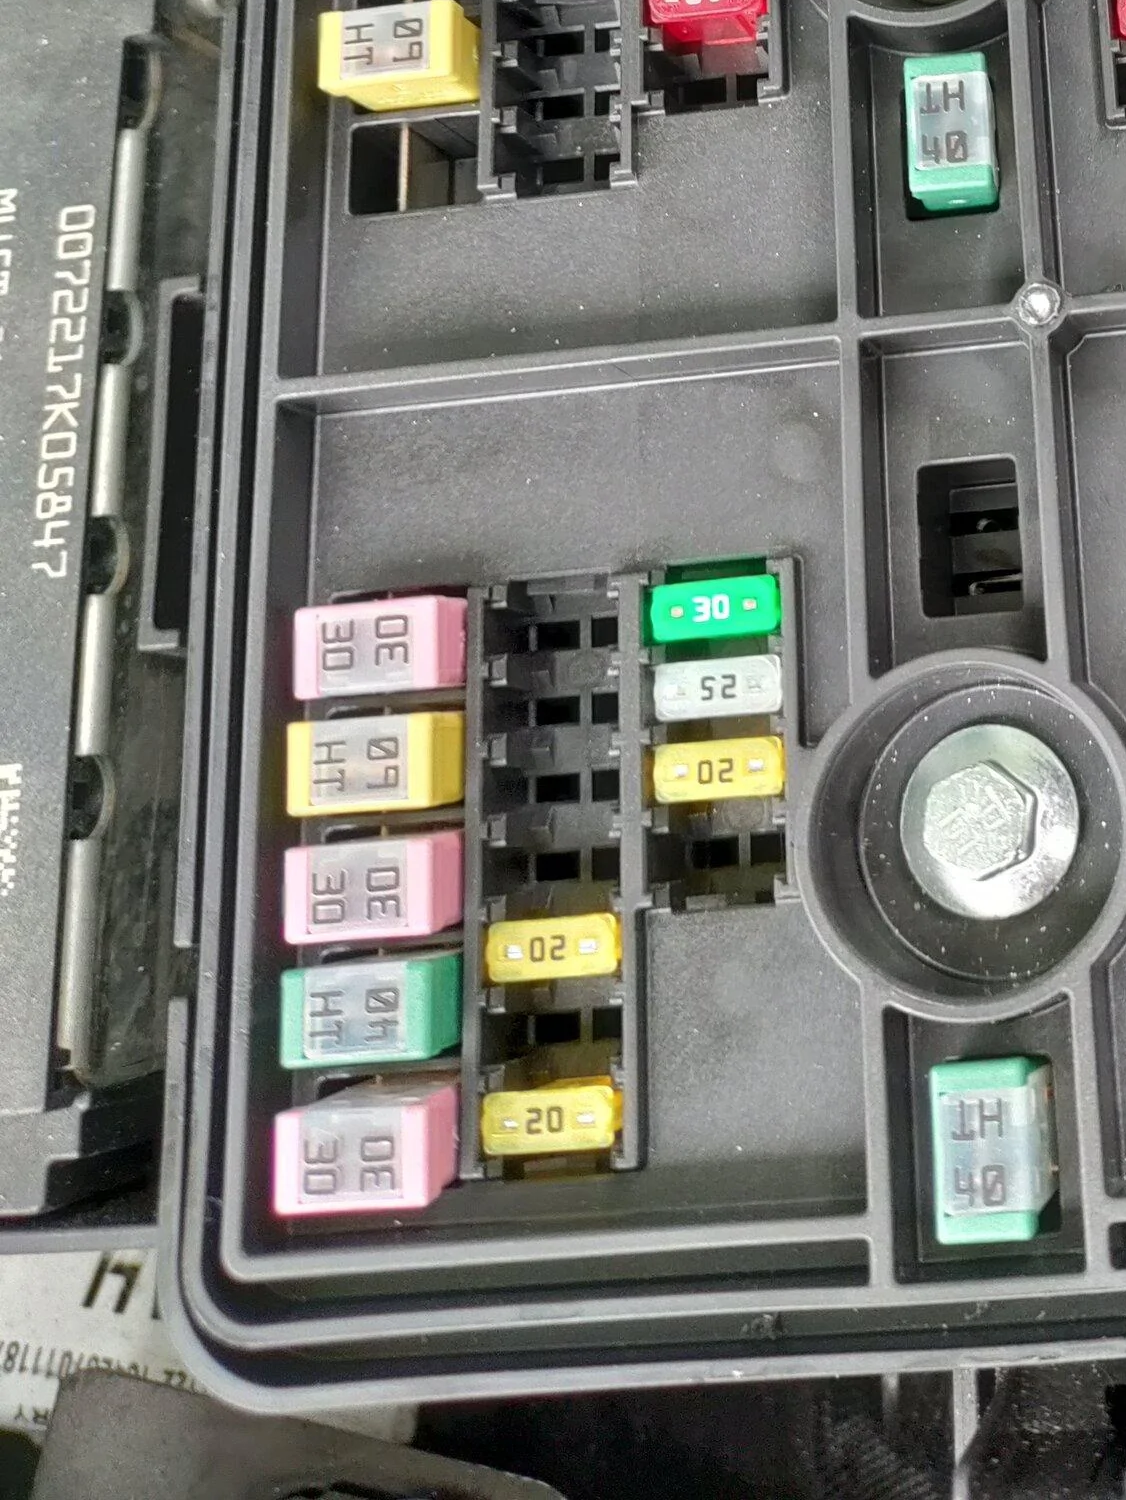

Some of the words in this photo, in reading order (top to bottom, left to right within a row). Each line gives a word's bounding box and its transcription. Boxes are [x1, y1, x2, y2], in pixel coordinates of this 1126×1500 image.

[344, 22, 374, 65] HT
[393, 17, 423, 62] 60
[920, 79, 965, 114] HT
[921, 130, 968, 164] 40
[691, 593, 730, 623] 30
[321, 619, 354, 671] 30
[374, 614, 409, 665] 30
[313, 740, 346, 791] HT
[367, 736, 399, 789] 60
[698, 758, 734, 784] 20
[312, 870, 346, 925] 30
[365, 866, 400, 921] 30
[529, 935, 565, 963] 20
[309, 989, 345, 1047] HT
[364, 987, 400, 1043] 40
[526, 1106, 564, 1135] 20
[952, 1098, 1003, 1140] HT
[303, 1138, 339, 1195] 30
[359, 1135, 395, 1193] 30
[954, 1165, 1006, 1207] 40
